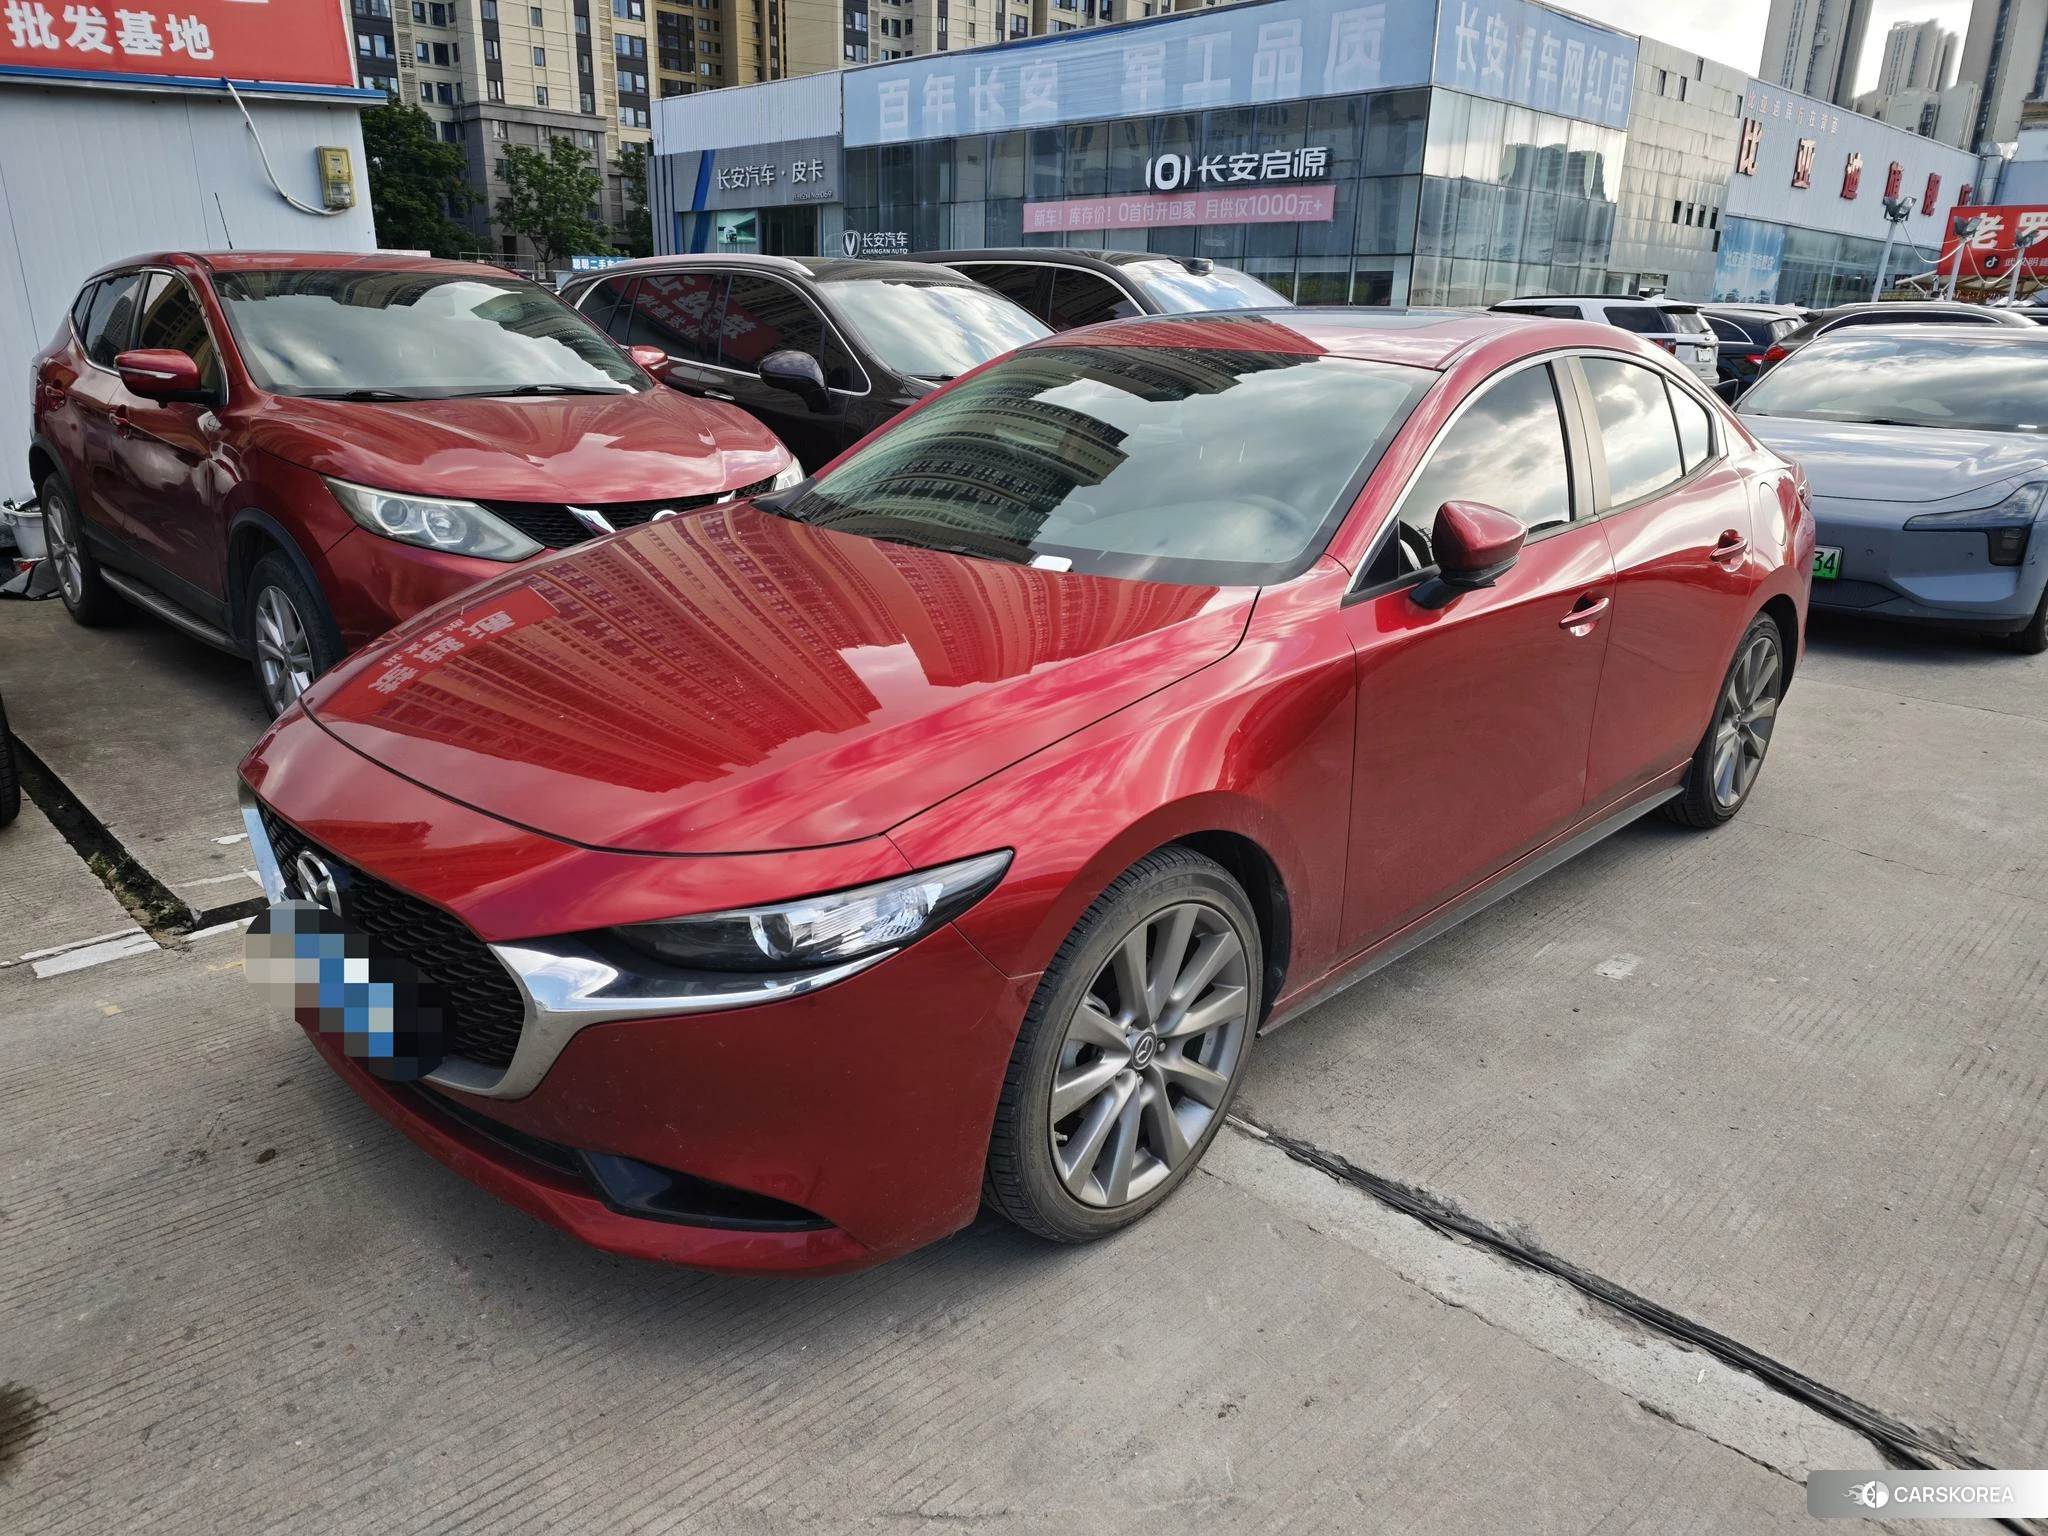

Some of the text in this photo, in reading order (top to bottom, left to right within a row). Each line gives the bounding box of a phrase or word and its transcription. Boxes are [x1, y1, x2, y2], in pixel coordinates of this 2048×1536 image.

[4, 0, 214, 60] 批发基地
[878, 3, 1386, 129] 百年长安 军工品质
[1198, 147, 1328, 183] 长安启源
[863, 232, 908, 247] 长安汽车
